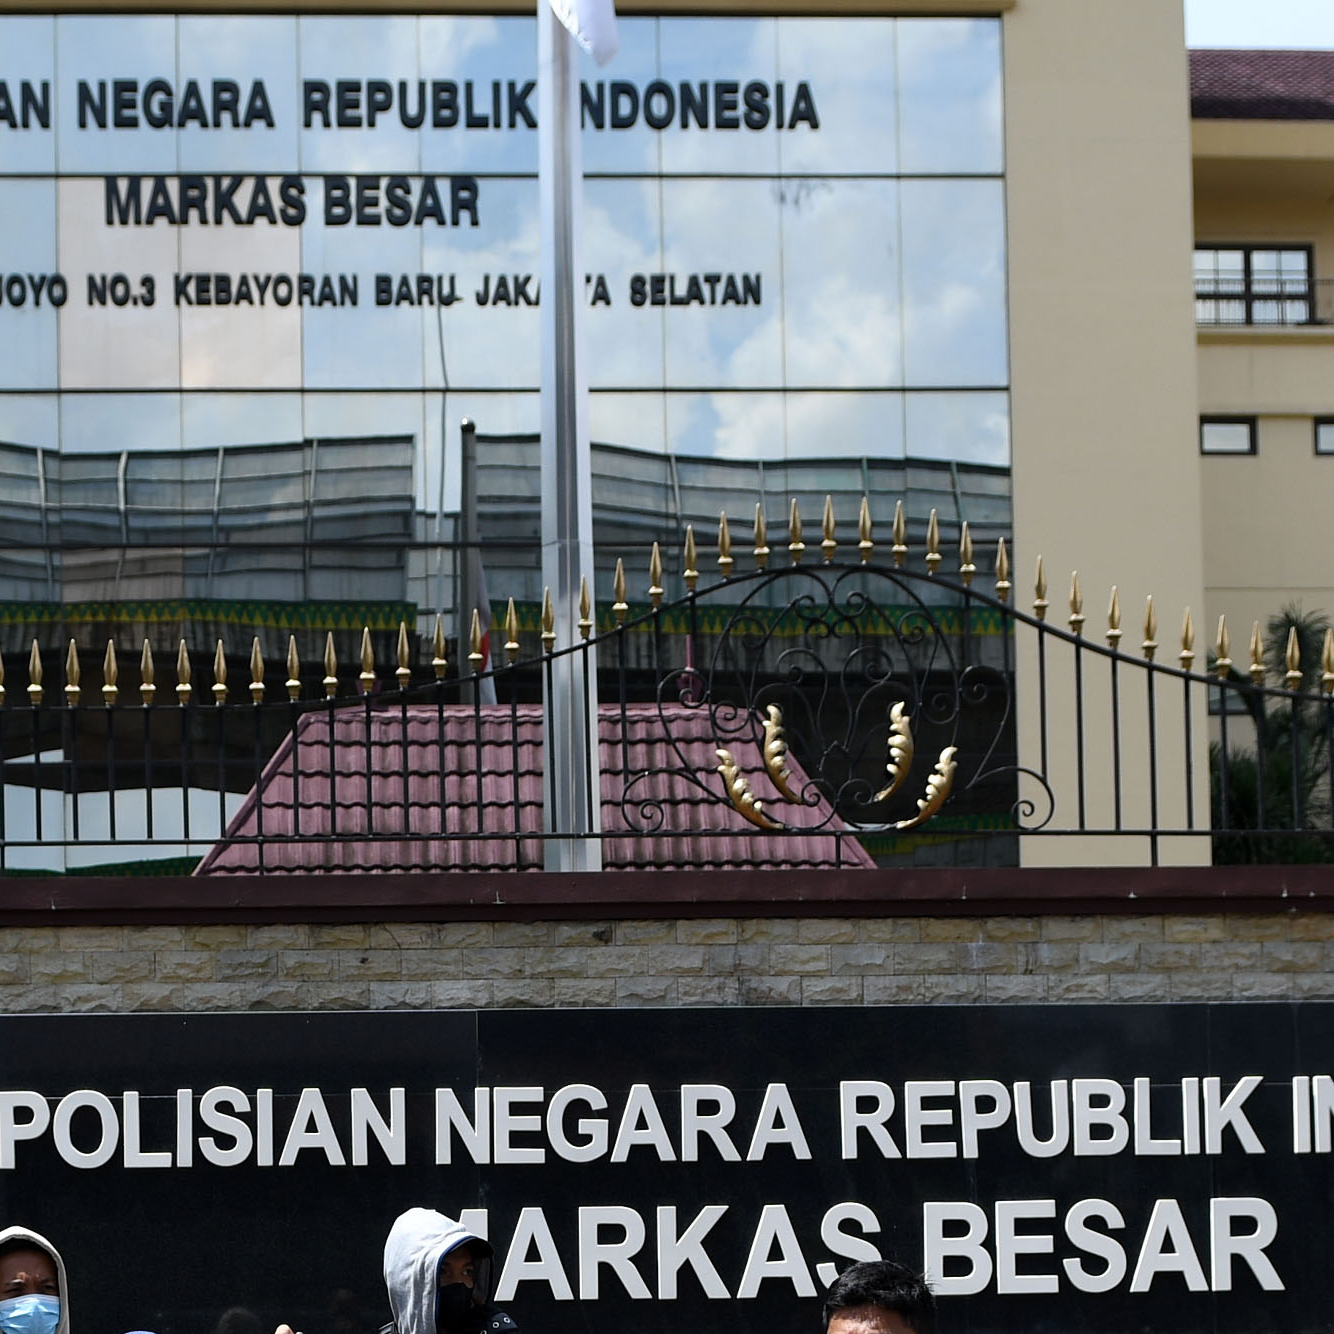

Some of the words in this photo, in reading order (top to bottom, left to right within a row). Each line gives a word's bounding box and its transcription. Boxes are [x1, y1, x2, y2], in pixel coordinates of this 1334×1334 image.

[77, 78, 274, 130] NEGARA
[303, 78, 538, 130] REPUBLIK
[580, 79, 821, 131] NDONESIA
[104, 176, 306, 227] MARKAS
[323, 176, 480, 227] BESAR
[87, 273, 156, 308] NO.3
[173, 273, 359, 308] KEBAYORAN
[375, 273, 457, 308] BARU
[630, 273, 762, 308] SELATAN
[435, 1082, 813, 1165] NEGARA
[839, 1075, 1266, 1160] REPUBLIK
[460, 1201, 883, 1302] ARKAS
[923, 1197, 1286, 1296] BESAR
